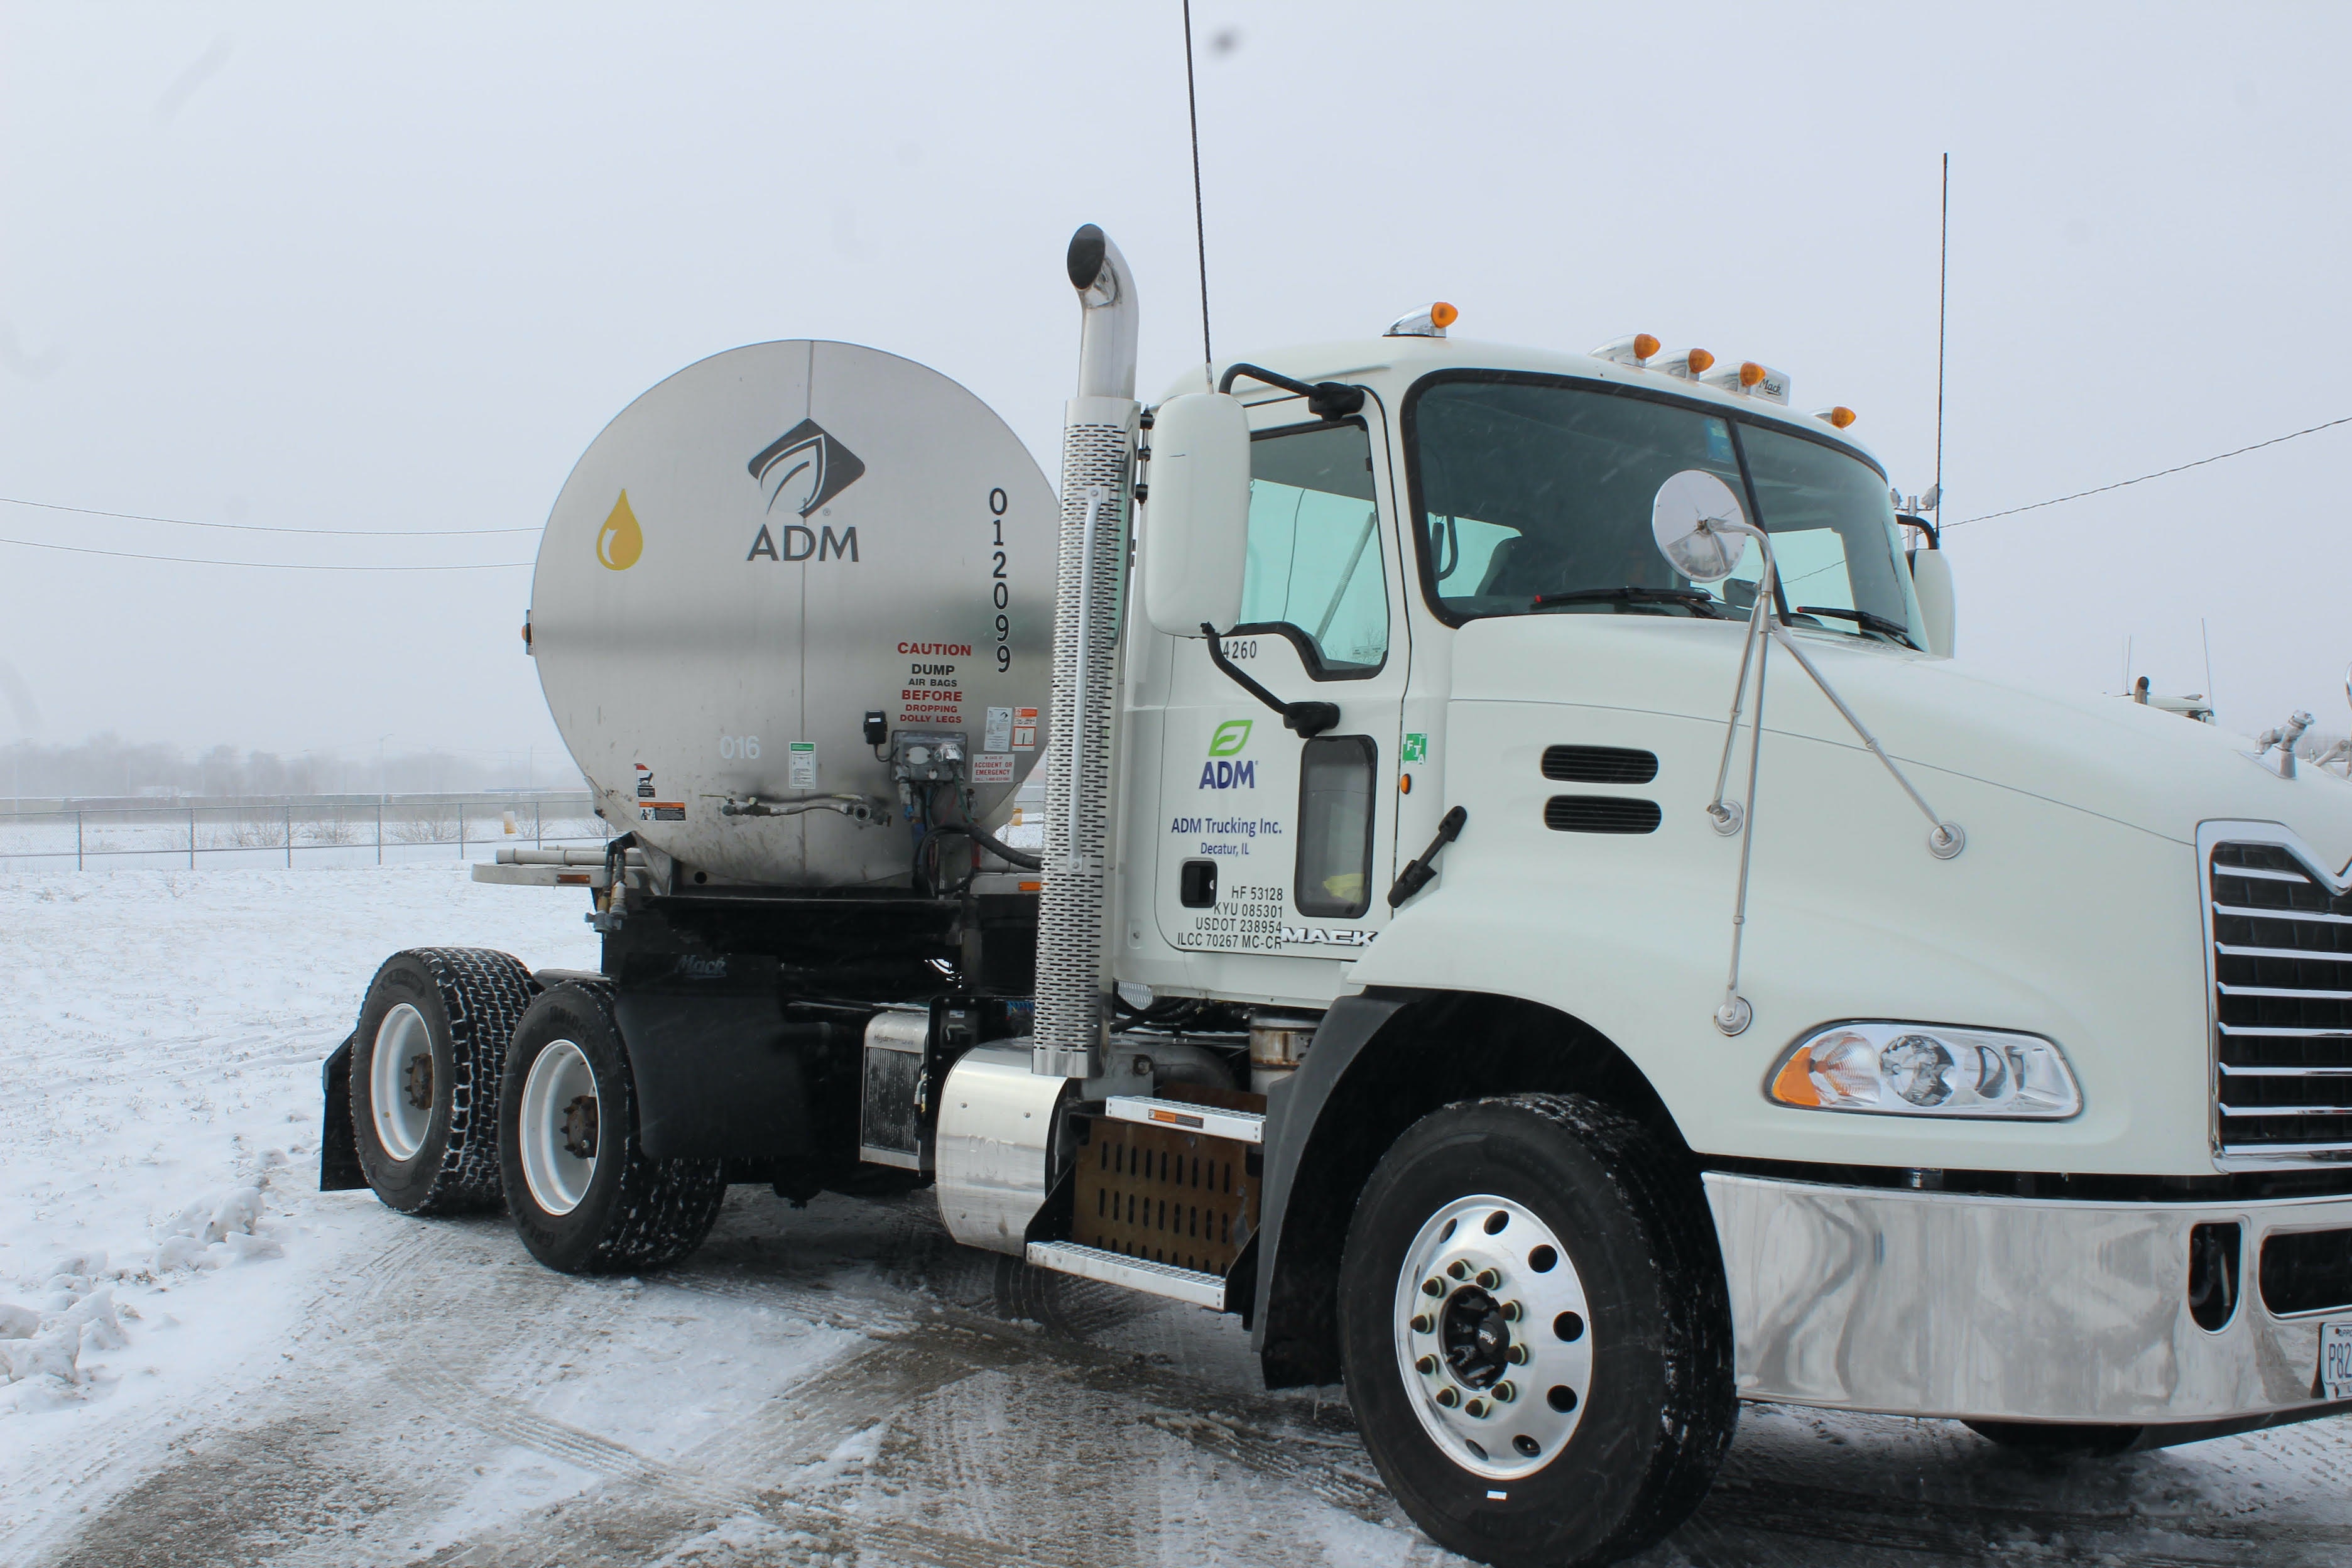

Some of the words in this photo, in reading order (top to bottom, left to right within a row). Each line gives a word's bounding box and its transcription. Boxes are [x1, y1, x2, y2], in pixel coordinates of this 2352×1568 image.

[1758, 378, 1782, 396] Mack
[746, 523, 859, 562] ADM
[897, 642, 972, 656] CAUTION
[911, 663, 955, 676] DUMP
[930, 678, 957, 687] BAGS
[901, 690, 962, 702] BEFORE
[905, 704, 957, 713] DROPPING
[900, 714, 932, 722] DOLLY
[720, 736, 761, 759] 016
[1199, 761, 1255, 790] ADM
[1171, 818, 1201, 833] ADM
[1206, 817, 1256, 837] Trucking
[1260, 818, 1282, 834] Inc.
[1200, 842, 1238, 857] Decatur,
[1241, 843, 1249, 855] IL
[1251, 887, 1283, 901] 53128
[1214, 902, 1238, 915] KYU
[1241, 903, 1283, 918] 085301
[1196, 917, 1237, 932] USDOT
[1240, 919, 1282, 934] 238954
[1177, 932, 1202, 946] ILCC
[1206, 934, 1238, 947] 70267
[1242, 935, 1282, 949] MC-CR
[1280, 927, 1378, 946] MACK
[673, 954, 727, 978] Mack
